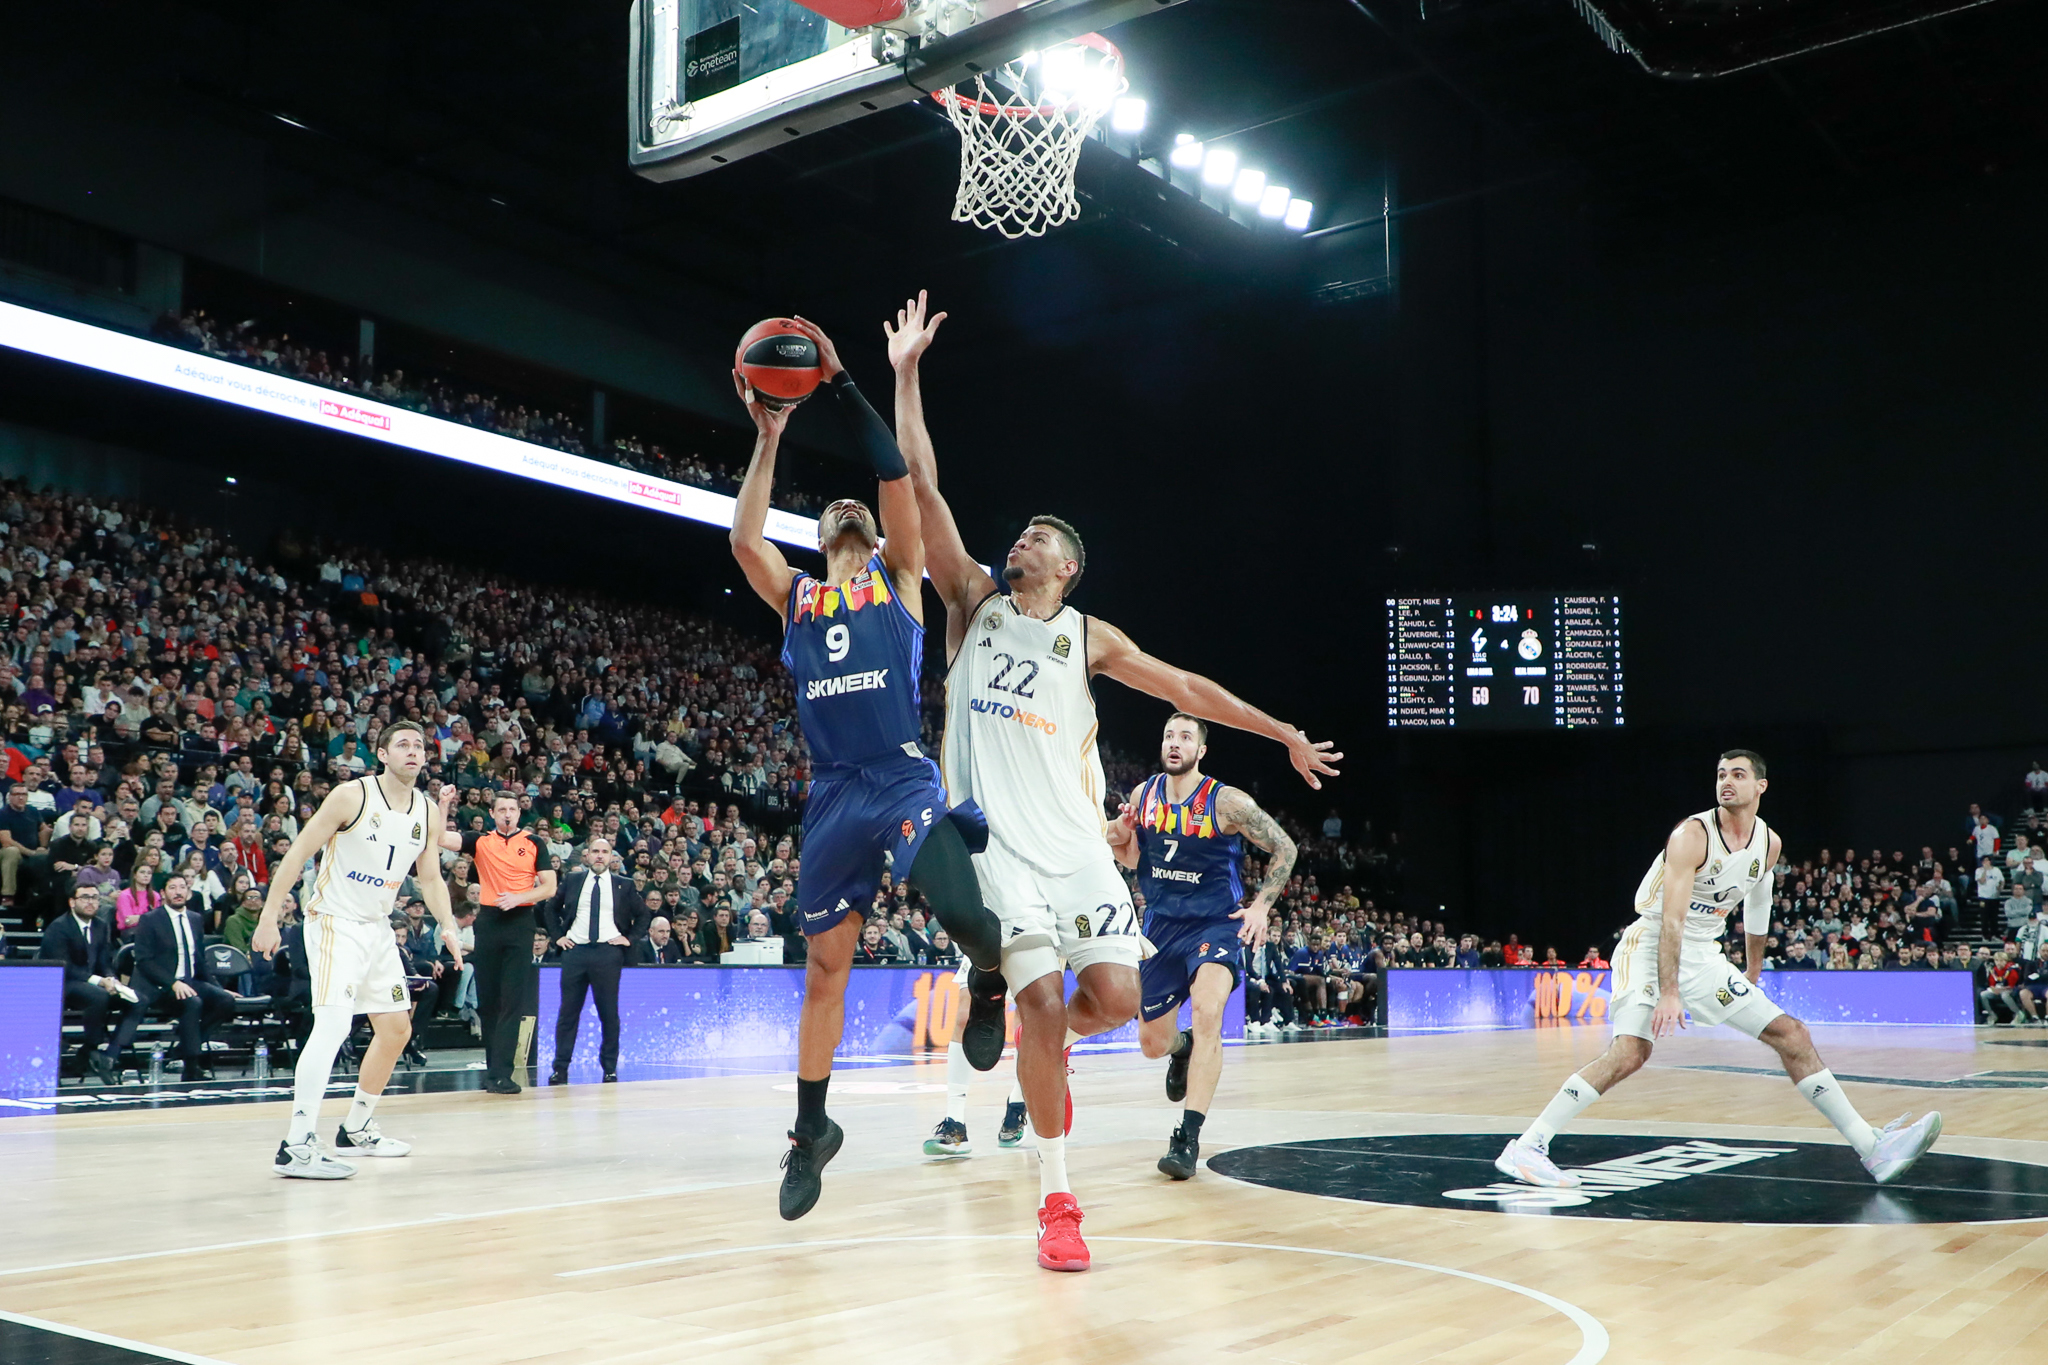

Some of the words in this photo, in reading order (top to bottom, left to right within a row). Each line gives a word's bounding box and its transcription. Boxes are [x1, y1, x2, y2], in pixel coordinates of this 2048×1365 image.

[700, 51, 737, 71] oneteam
[175, 364, 225, 386] Adéquat
[228, 380, 252, 392] vous
[256, 386, 306, 406] décroche
[309, 399, 318, 410] le
[321, 402, 338, 415] job
[340, 406, 384, 427] Adéquat
[561, 466, 579, 477] vous
[826, 624, 850, 662] 9
[1501, 639, 1508, 649] 4
[806, 669, 889, 700] SKWEEK
[987, 652, 1039, 699] 22
[1472, 687, 1489, 705] 59
[1523, 686, 1540, 705] 70
[971, 698, 1057, 735] AUTOHERO
[386, 844, 395, 870] 1
[1164, 839, 1179, 862] 7
[1096, 901, 1137, 937] 22
[1690, 901, 1729, 917] UTOHE
[1214, 947, 1229, 958] 7
[1534, 971, 1606, 1017] 100%
[1727, 974, 1749, 997] 6
